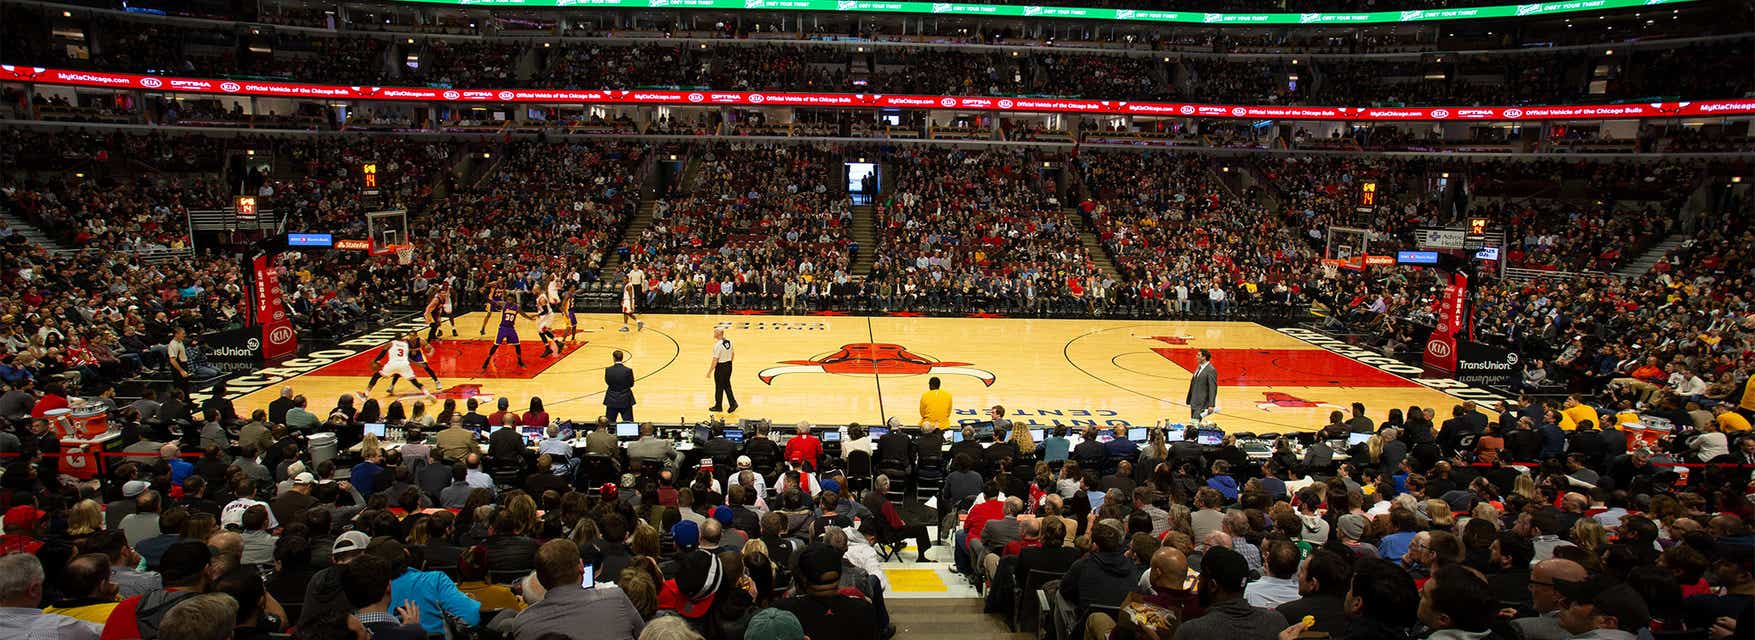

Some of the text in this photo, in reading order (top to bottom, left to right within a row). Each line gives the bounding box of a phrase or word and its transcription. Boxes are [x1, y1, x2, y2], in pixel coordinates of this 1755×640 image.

[141, 79, 161, 87] KIA
[221, 82, 239, 91] KIA
[444, 91, 459, 99] KIA
[689, 93, 703, 101] KIA
[750, 94, 763, 102] KIA
[942, 98, 955, 106] KIA
[366, 174, 375, 187] 14
[1364, 192, 1373, 205] 14
[272, 331, 290, 342] KIA
[1276, 327, 1424, 374] CHICAGO
[1431, 341, 1447, 354] KIA
[397, 348, 404, 357] 3
[1459, 359, 1511, 370] TransUnion
